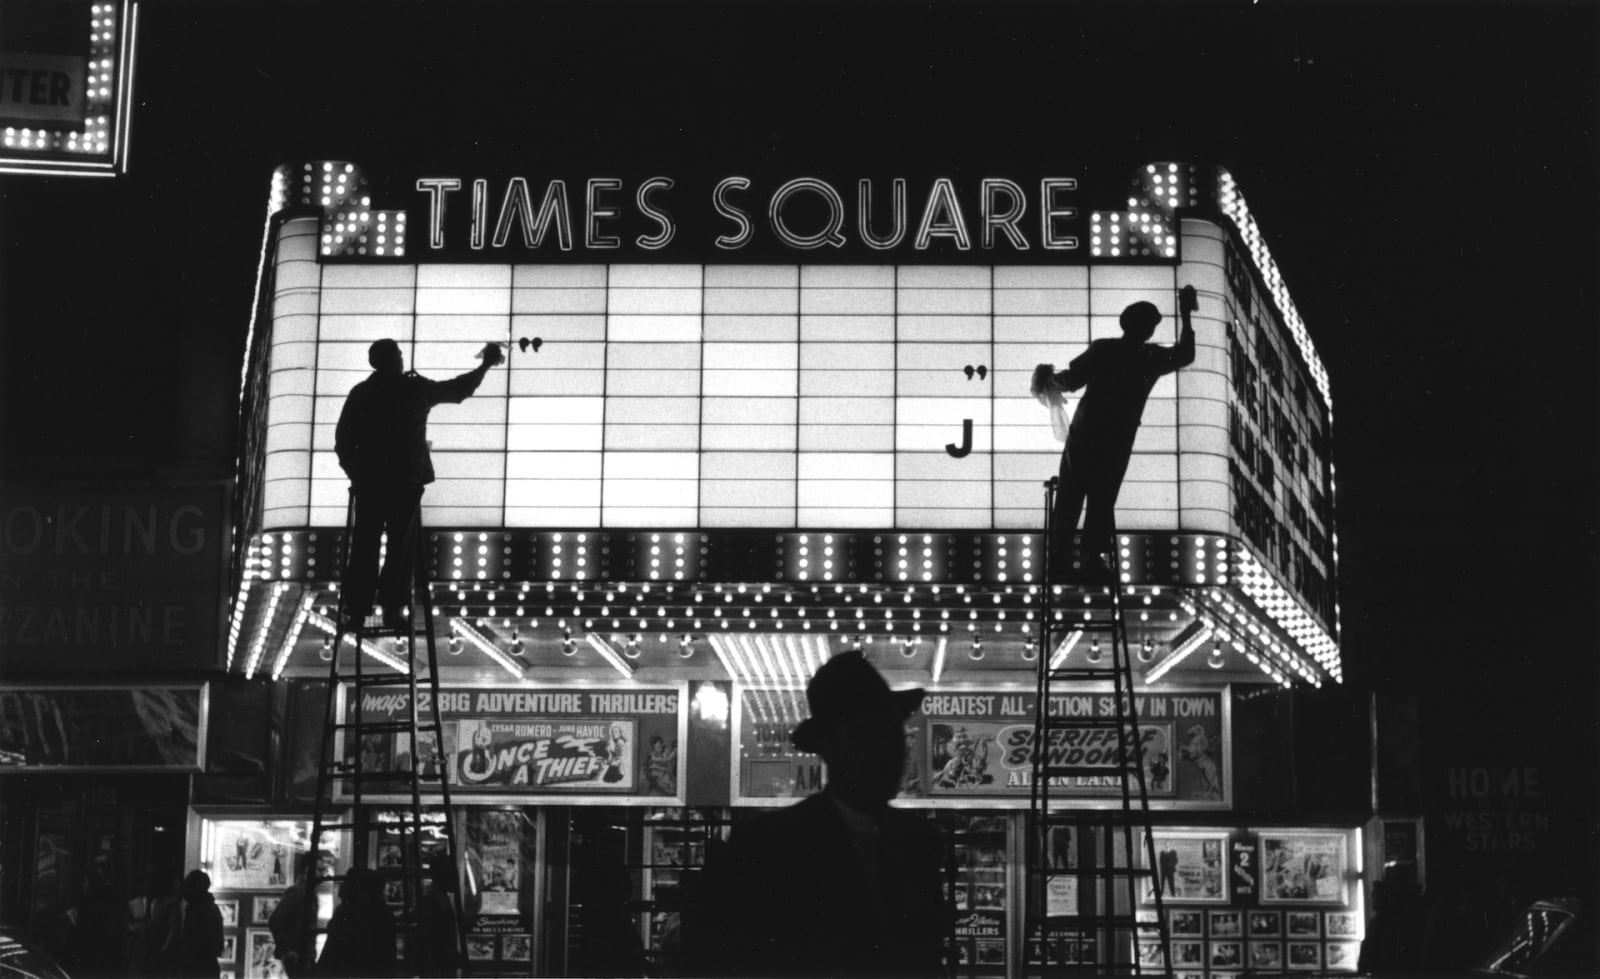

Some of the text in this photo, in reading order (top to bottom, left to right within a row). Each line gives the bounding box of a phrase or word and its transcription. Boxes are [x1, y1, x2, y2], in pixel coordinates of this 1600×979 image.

[416, 177, 1079, 251] TIMES SQUARE
[945, 418, 973, 458] J
[49, 570, 120, 590] THE
[417, 693, 431, 712] 2
[437, 692, 471, 712] BIG
[476, 693, 582, 713] ADVENTURE
[589, 694, 678, 714] THRILLERS
[921, 696, 995, 716] GREATEST
[1150, 698, 1167, 716] IN
[1171, 697, 1216, 717] TOWN
[515, 724, 552, 738] ROMERO
[576, 725, 605, 738] HAVOC
[463, 739, 551, 782] ONCE
[513, 756, 601, 785] A THIEF
[1449, 767, 1541, 798] HOME
[1239, 852, 1250, 867] 2
[968, 913, 979, 928] 2
[954, 927, 1000, 937] HRILLERS
